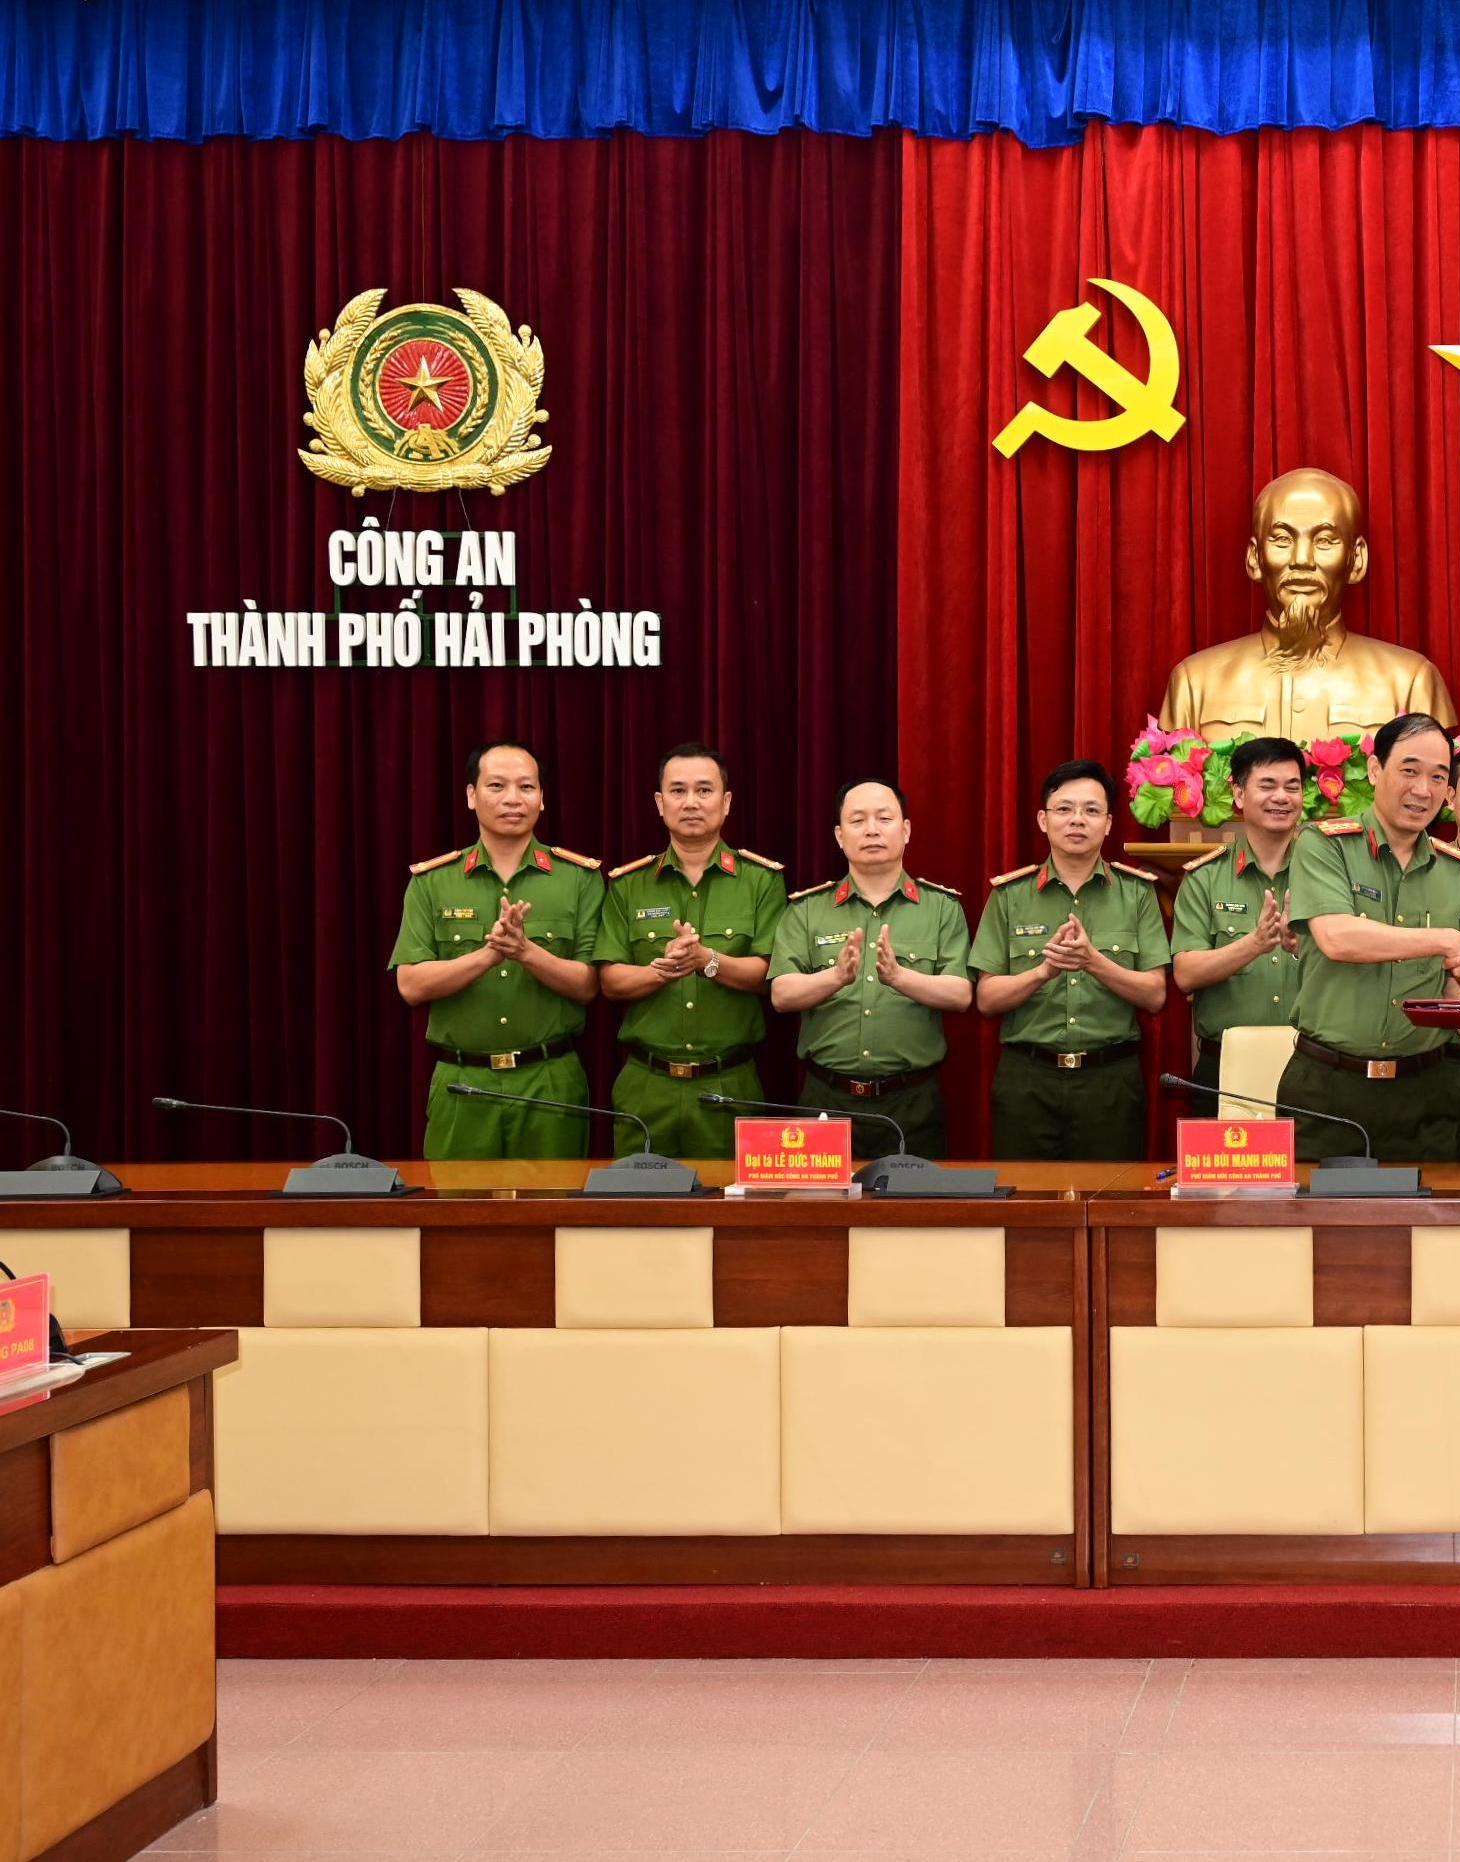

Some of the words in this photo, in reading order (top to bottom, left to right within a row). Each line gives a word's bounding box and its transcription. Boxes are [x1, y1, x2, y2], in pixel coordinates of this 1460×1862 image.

[329, 517, 443, 585] CÔNG
[456, 531, 515, 585] AN
[187, 599, 325, 666] THÀNH
[339, 590, 422, 666] PHỐ
[435, 592, 505, 666] HẢI
[519, 599, 660, 666] PHÒNG
[745, 1152, 760, 1170] Đại
[788, 1152, 808, 1168] ĐỨC
[810, 1152, 842, 1168] THÀNH
